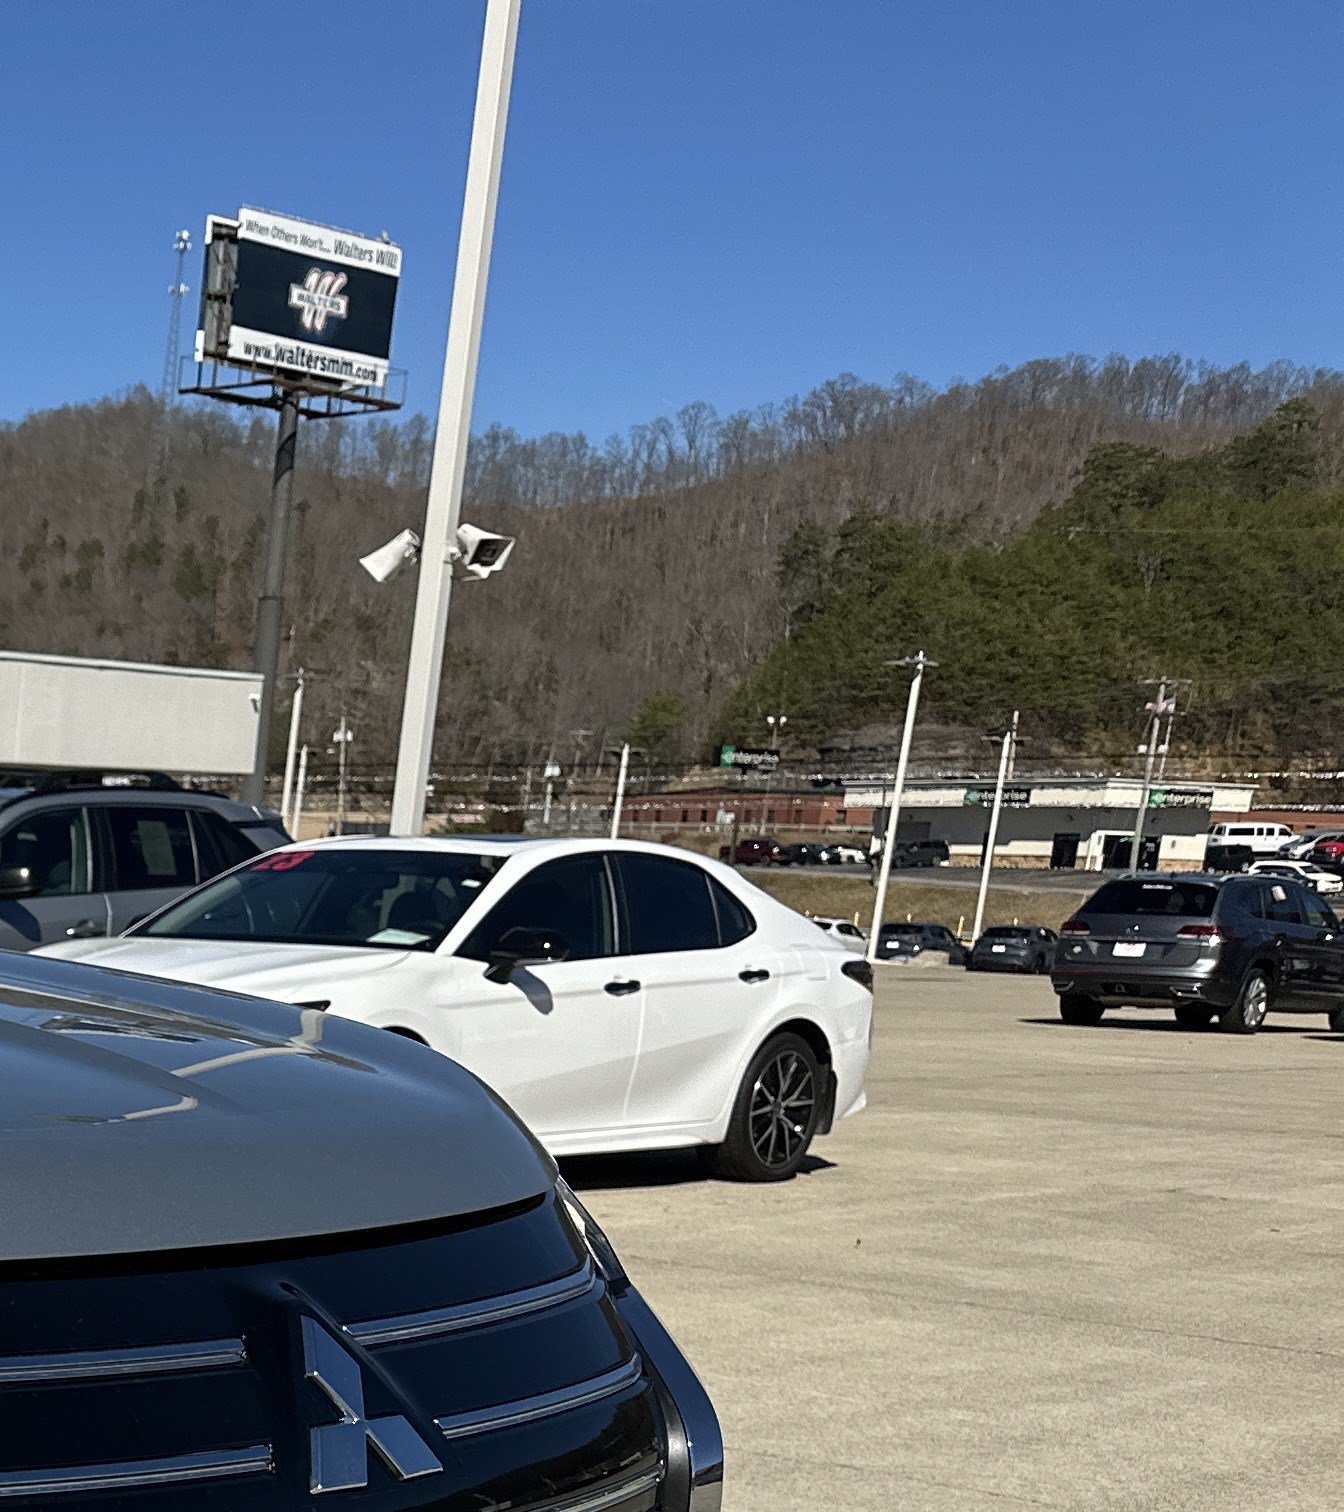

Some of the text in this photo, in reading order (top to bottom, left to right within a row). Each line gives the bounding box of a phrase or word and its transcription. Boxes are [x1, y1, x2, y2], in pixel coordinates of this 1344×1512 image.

[245, 219, 270, 237] When
[271, 225, 299, 245] Others
[333, 239, 374, 263] Walters
